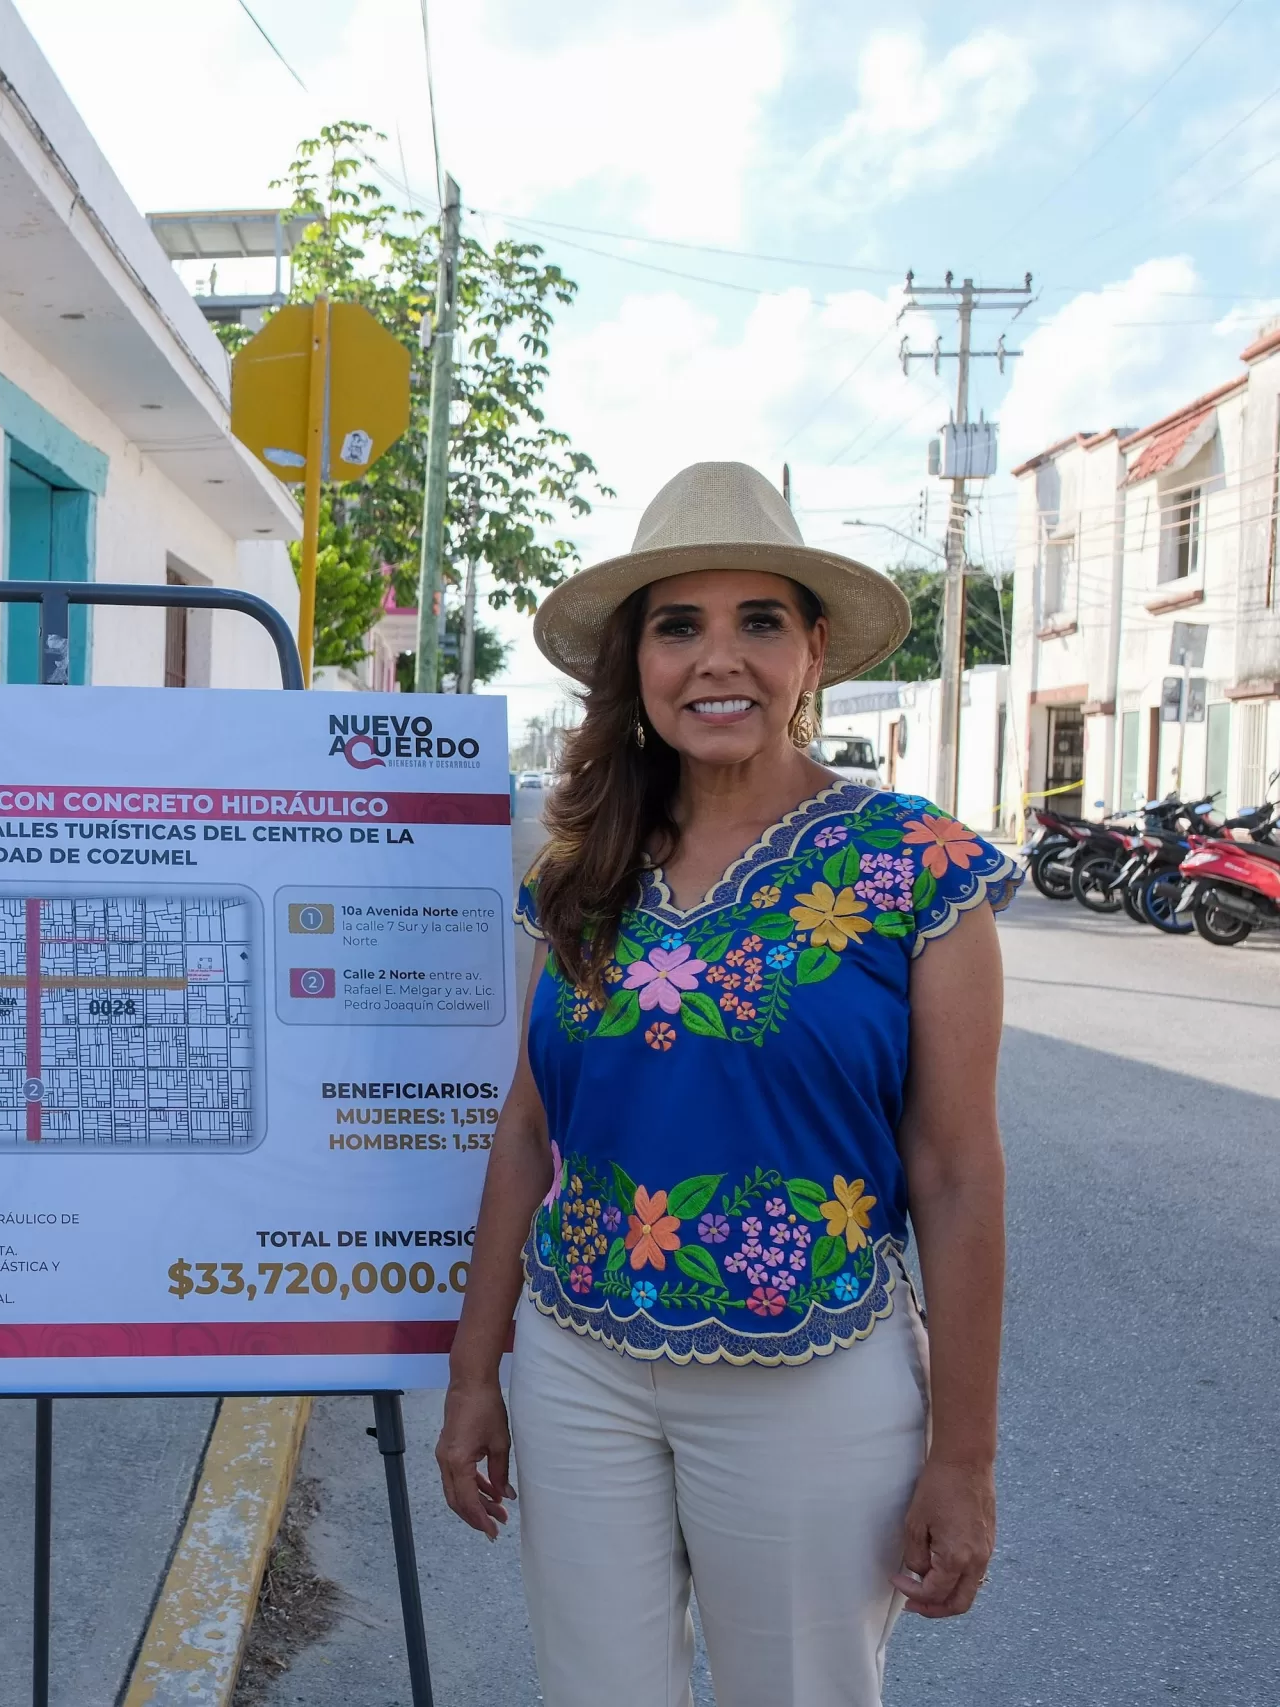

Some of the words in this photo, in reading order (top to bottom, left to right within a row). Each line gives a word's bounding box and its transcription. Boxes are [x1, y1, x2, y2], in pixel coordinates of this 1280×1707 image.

[330, 714, 432, 736] NUEVO
[388, 759, 426, 768] BIENESTAR
[429, 760, 433, 768] Y
[436, 760, 480, 768] DESARROLLO
[64, 792, 214, 814] CONCRETO
[222, 792, 388, 817] HIDRÁULICO
[65, 819, 197, 841] TURÍSTICAS
[204, 825, 246, 842] DEL
[253, 826, 342, 843] CENTRO
[350, 828, 379, 843] DE
[386, 829, 414, 844] LA
[50, 848, 80, 864] DE
[88, 849, 197, 865] COZUMEL
[342, 906, 362, 916] 10a
[366, 906, 418, 916] Avenida
[423, 907, 458, 916] Norte
[462, 909, 494, 917] entre
[343, 921, 352, 931] la
[356, 922, 384, 931] calle
[387, 922, 394, 931] 7
[398, 923, 418, 932] Sur
[421, 925, 427, 934] y
[432, 923, 441, 932] la
[445, 923, 473, 932] calle
[477, 923, 488, 932] 10
[343, 936, 377, 946] Norte
[344, 970, 375, 979] Calle
[379, 970, 386, 979] 2
[390, 971, 425, 980] Norte
[430, 972, 462, 980] entre
[465, 972, 481, 980] av.
[308, 977, 317, 988] 2
[345, 985, 381, 995] Rafael
[386, 985, 396, 995] E.
[400, 985, 441, 998] Melgar
[445, 987, 451, 998] y
[455, 987, 471, 995] av.
[475, 986, 494, 996] Lic.
[89, 1000, 136, 1015] 0028
[345, 1000, 381, 1010] Pedro
[384, 1001, 433, 1012] Joaquín
[437, 1001, 490, 1010] Coldwell
[30, 1084, 38, 1096] 2
[323, 1083, 498, 1098] BENEFICIARIOS:
[336, 1108, 445, 1124] MUJERES:
[451, 1108, 498, 1126] 1,519
[329, 1134, 447, 1150] HOMBRES:
[453, 1134, 495, 1152] 1,53
[61, 1214, 79, 1224] DE
[256, 1231, 331, 1247] TOTAL
[338, 1231, 367, 1246] DE
[375, 1226, 477, 1246] INVERSIÓ
[52, 1262, 60, 1272] Y
[168, 1258, 470, 1300] $33,720,000.0
